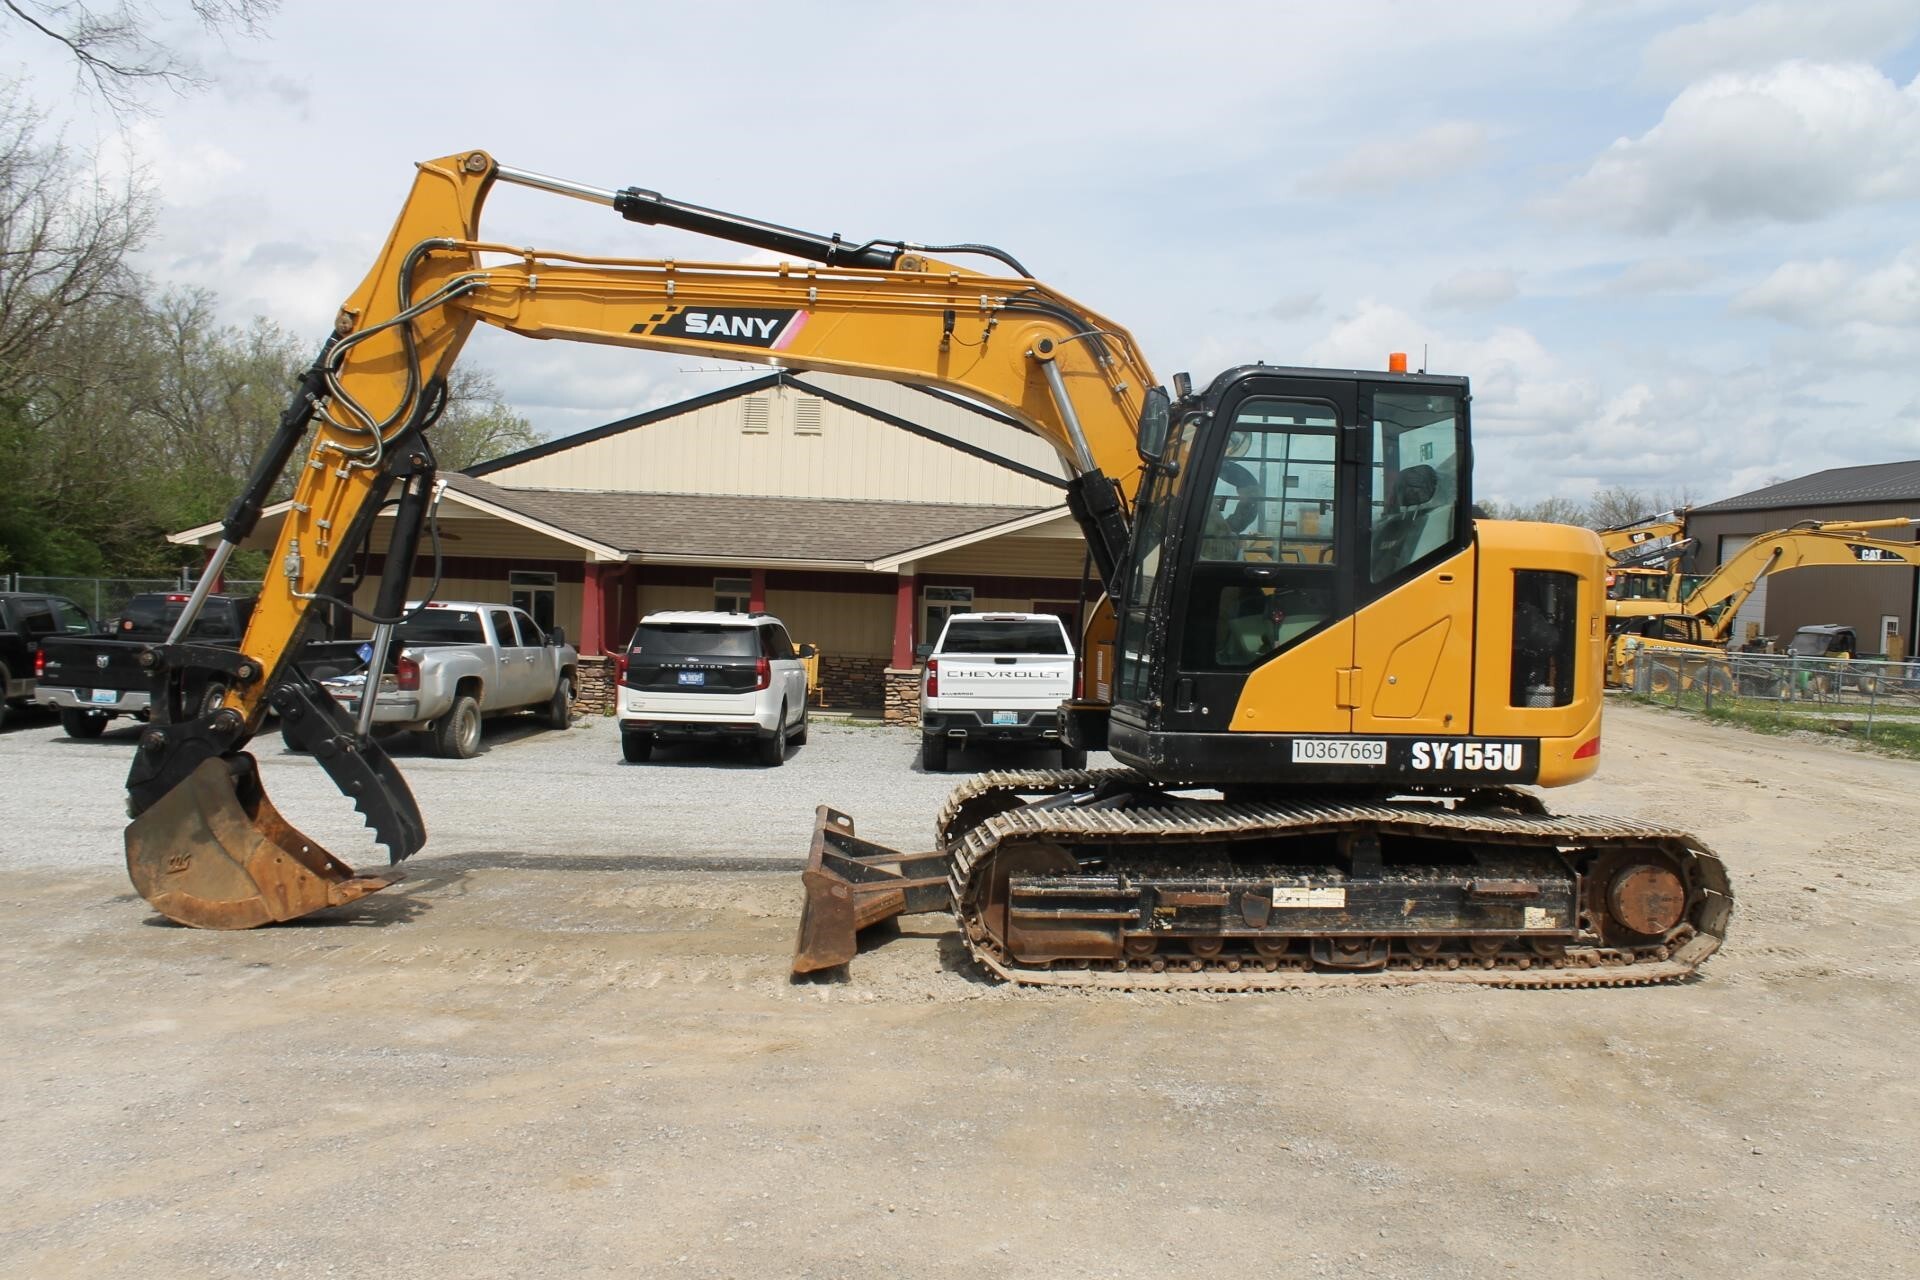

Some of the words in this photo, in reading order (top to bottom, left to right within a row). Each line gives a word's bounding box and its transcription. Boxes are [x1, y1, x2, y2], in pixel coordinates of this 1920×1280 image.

[685, 313, 779, 339] SANY
[1862, 549, 1883, 560] CAT
[1295, 741, 1383, 760] 10367669
[1411, 742, 1522, 771] SY155U
